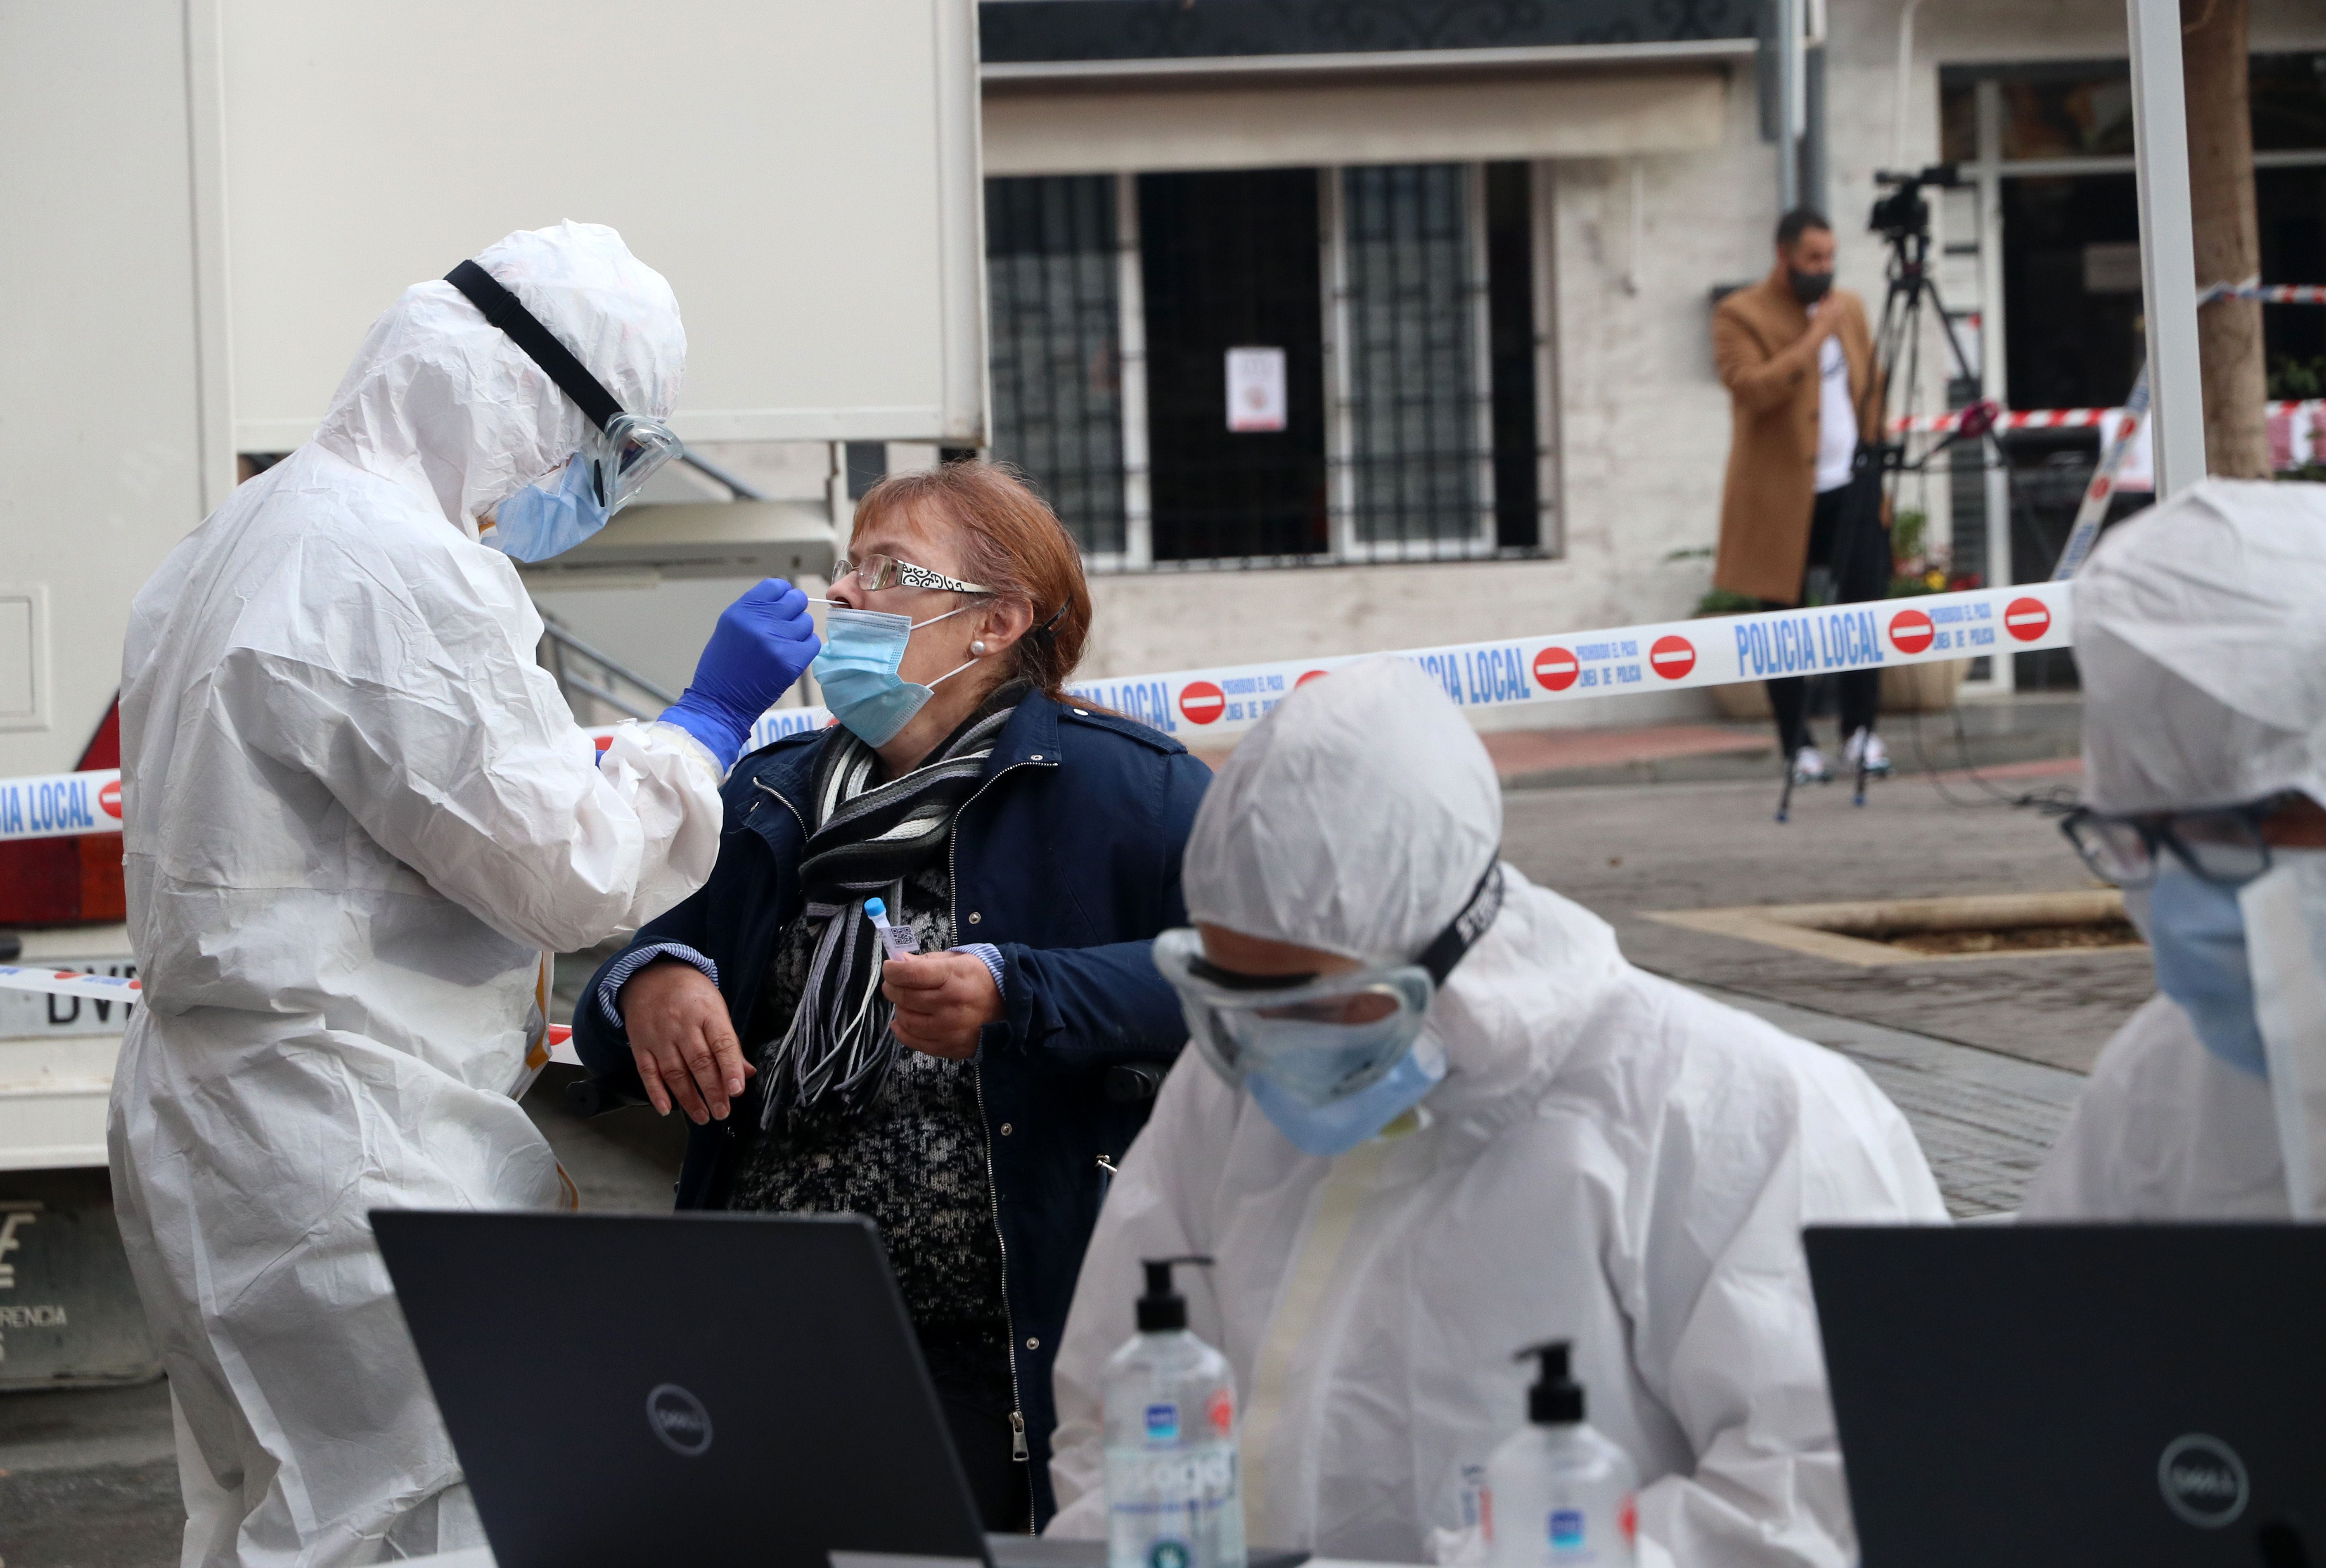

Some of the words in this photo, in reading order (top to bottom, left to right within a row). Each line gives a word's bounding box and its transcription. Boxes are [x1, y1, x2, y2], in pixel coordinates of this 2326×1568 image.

[1735, 618, 1816, 677] POLICIA
[1818, 611, 1883, 667] LOCAL
[1465, 648, 1531, 703] LOCAL
[28, 779, 94, 832] LOCAL
